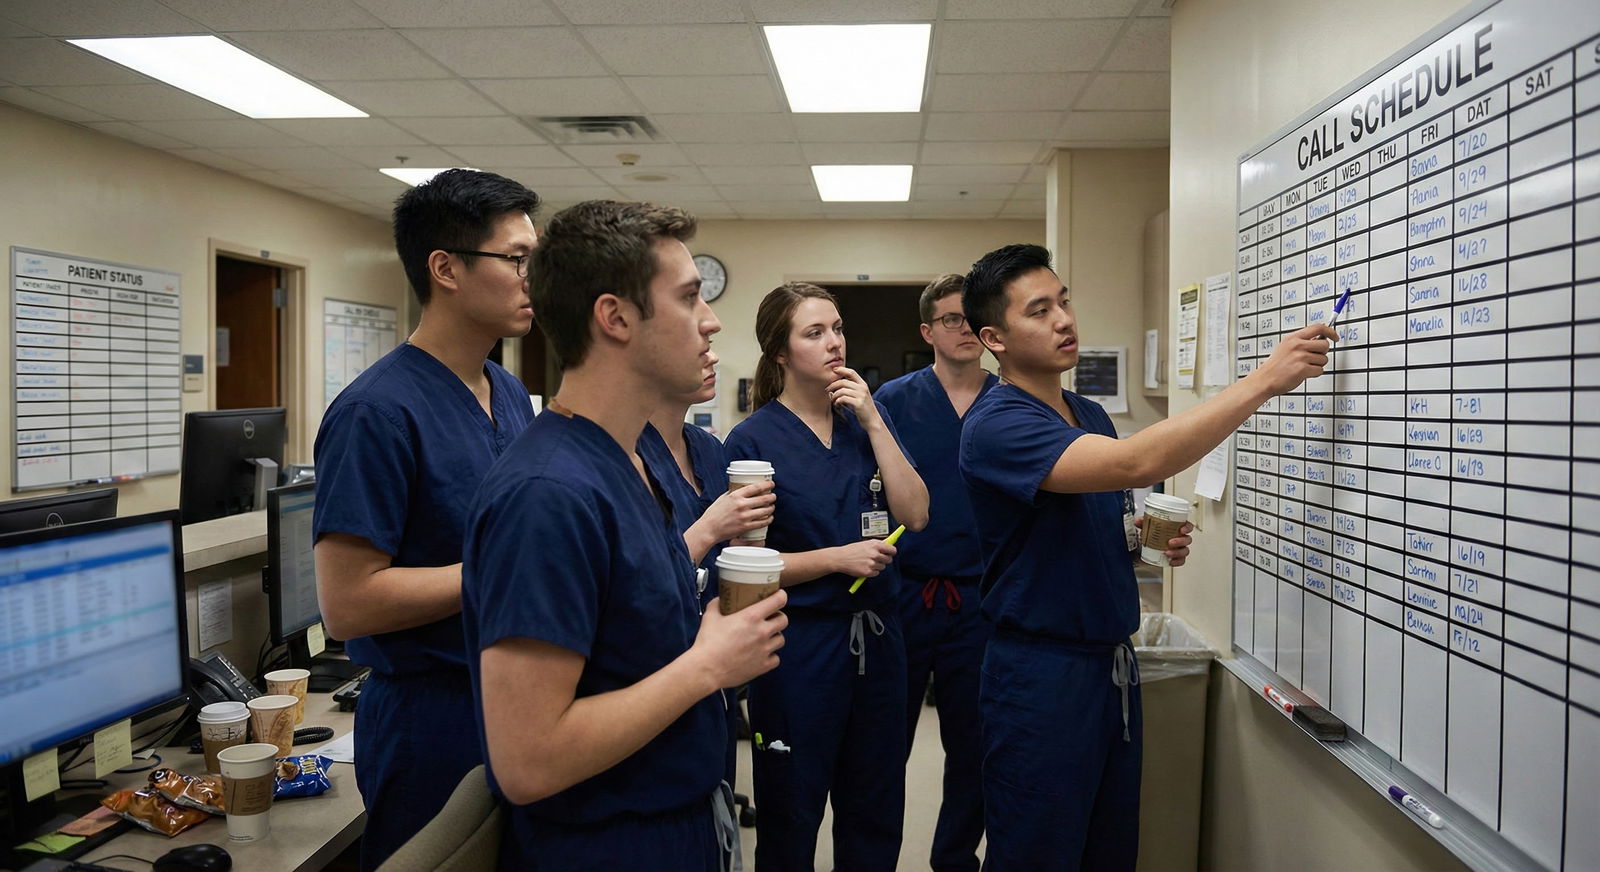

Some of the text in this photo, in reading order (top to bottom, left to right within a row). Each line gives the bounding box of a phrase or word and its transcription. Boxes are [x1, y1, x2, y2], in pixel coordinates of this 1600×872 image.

[1297, 23, 1493, 171] CALL SCHEDULE
[1285, 190, 1301, 207] MON
[1313, 177, 1328, 194] TUE
[1341, 161, 1361, 181] WED
[1377, 145, 1397, 165] THU
[1421, 124, 1439, 145] FRI
[1467, 97, 1491, 122] DAT
[1525, 66, 1554, 96] SAT
[1458, 132, 1487, 158] 7/20
[1459, 165, 1487, 191] 9/29
[1459, 199, 1488, 225] 9/24
[68, 264, 143, 286] PATIENT STATUS
[1458, 544, 1485, 566] 16/19
[1454, 573, 1478, 594] 7/21
